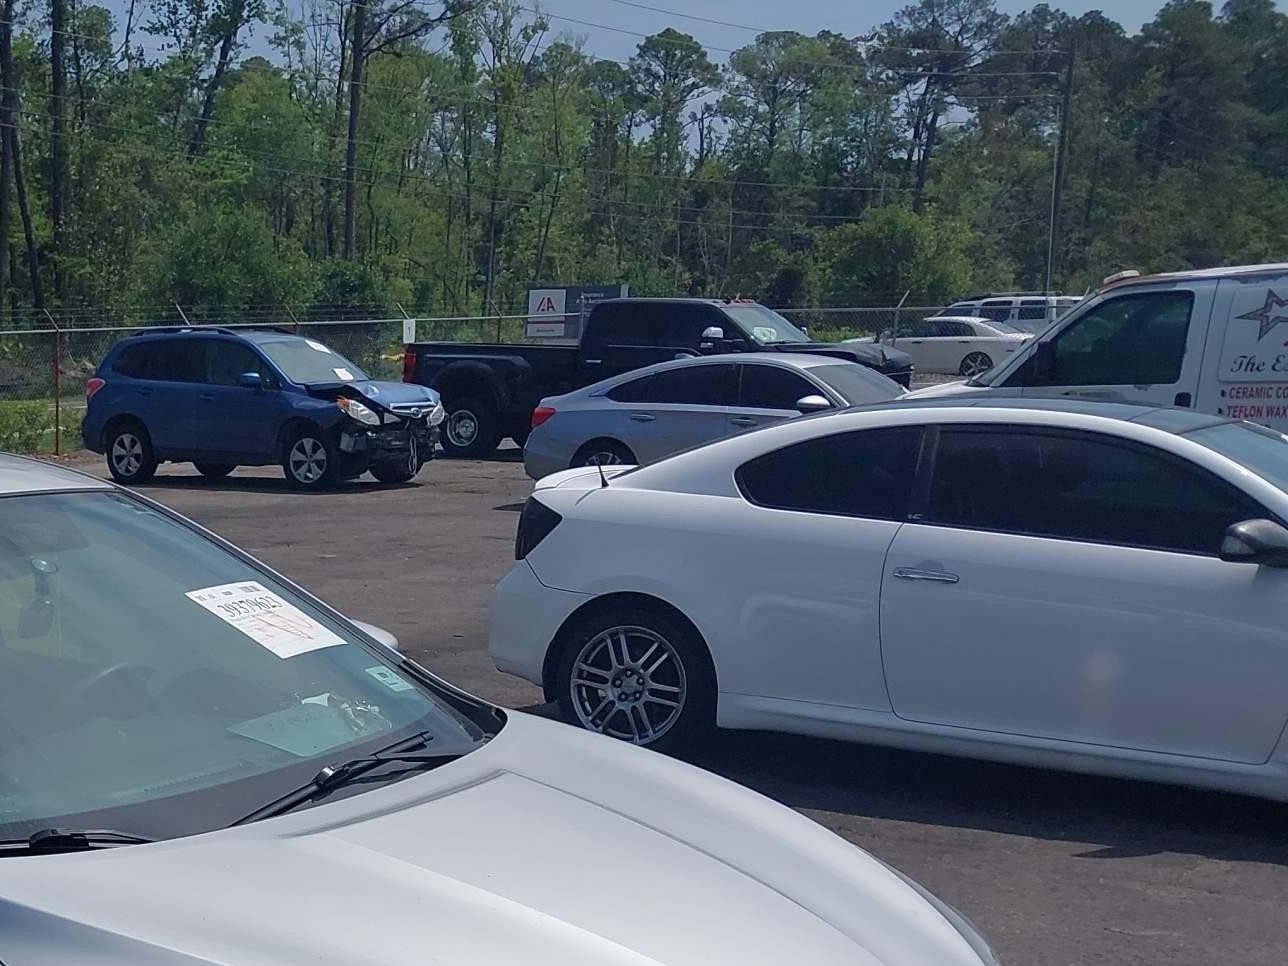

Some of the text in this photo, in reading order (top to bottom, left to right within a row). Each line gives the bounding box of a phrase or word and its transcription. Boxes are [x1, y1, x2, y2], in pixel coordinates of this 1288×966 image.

[1230, 355, 1266, 373] The
[1229, 386, 1273, 400] CERAMIC
[1226, 405, 1264, 418] TEFLON
[216, 595, 284, 618] 39379623
